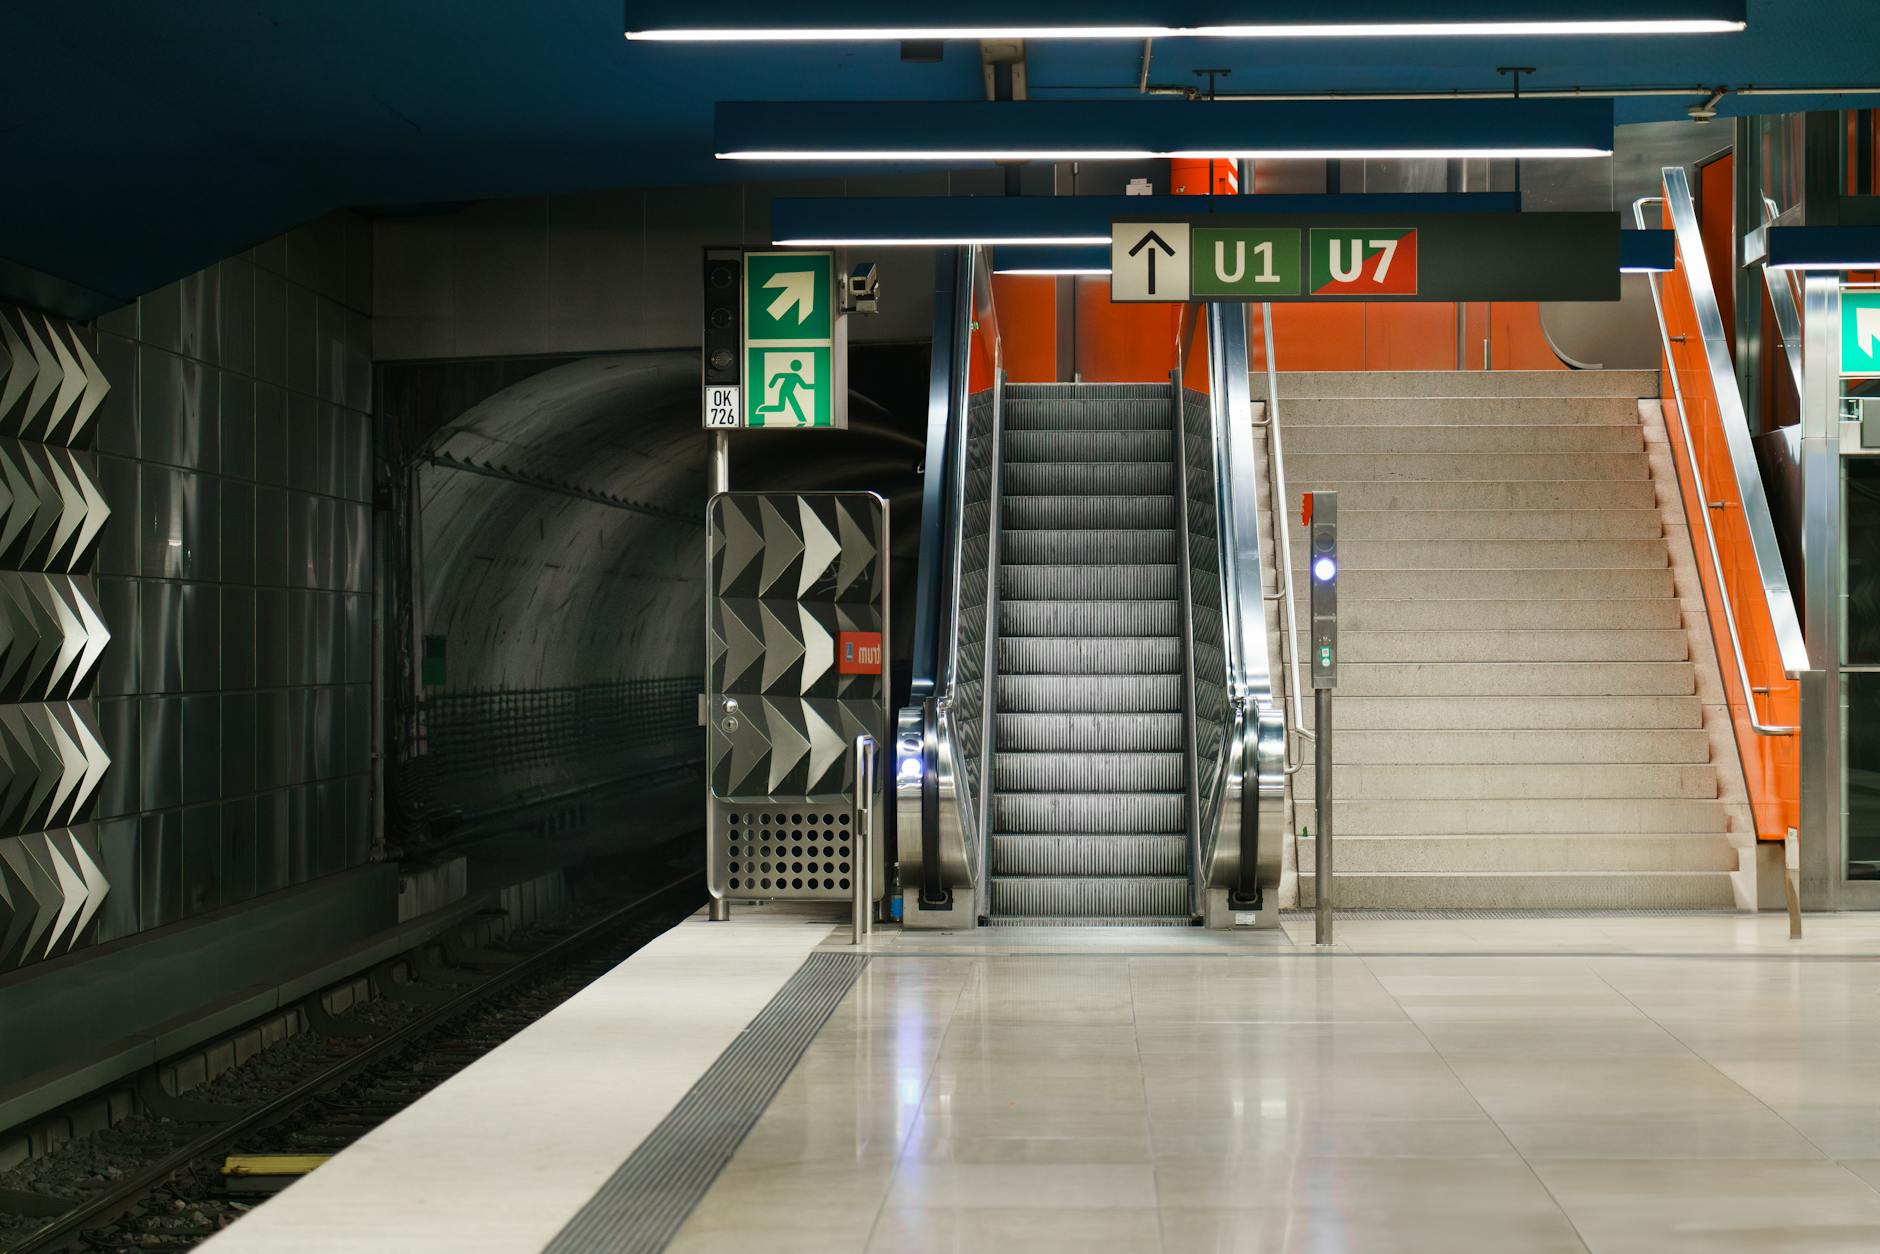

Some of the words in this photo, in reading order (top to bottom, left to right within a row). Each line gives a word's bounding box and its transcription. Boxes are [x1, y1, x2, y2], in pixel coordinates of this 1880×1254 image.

[1214, 241, 1281, 283] U1
[1329, 239, 1398, 284] U7
[714, 390, 732, 407] OK
[711, 408, 735, 425] 726
